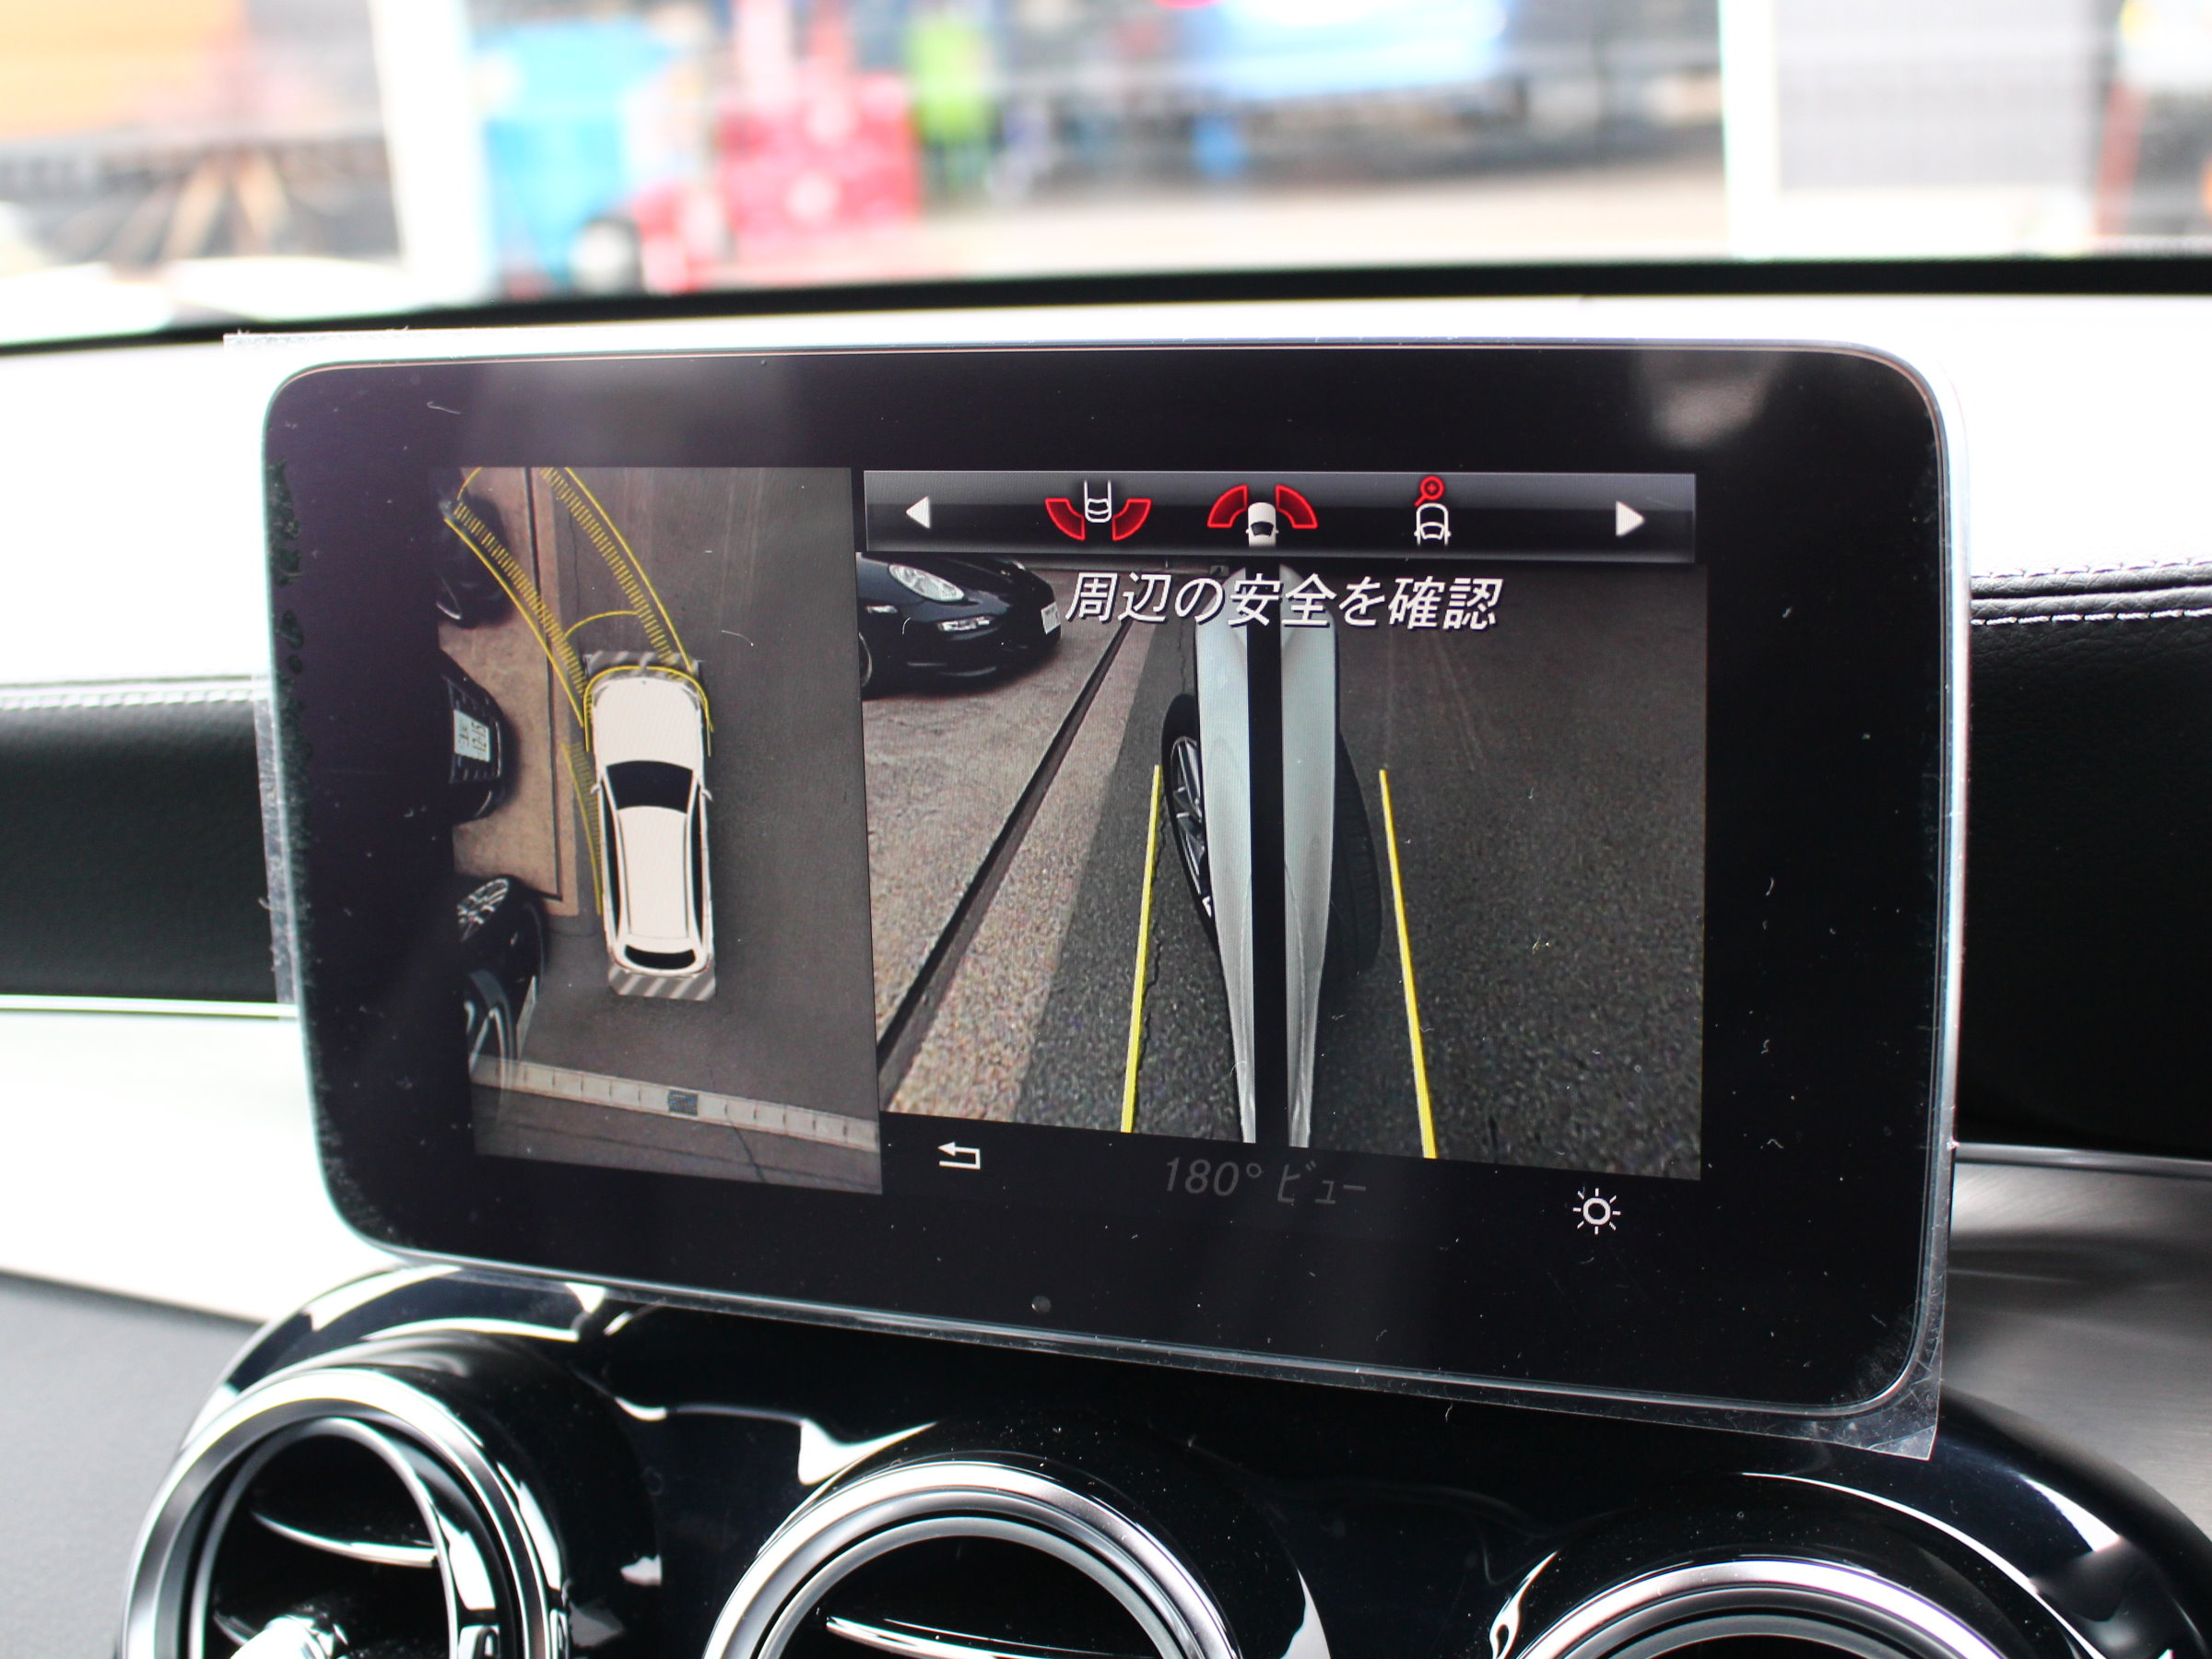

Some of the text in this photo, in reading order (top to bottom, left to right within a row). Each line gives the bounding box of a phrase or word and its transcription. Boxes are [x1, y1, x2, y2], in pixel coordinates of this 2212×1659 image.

[1065, 571, 1504, 630] 周辺の安全を確認
[1165, 1157, 1366, 1205] 180° ビュー
